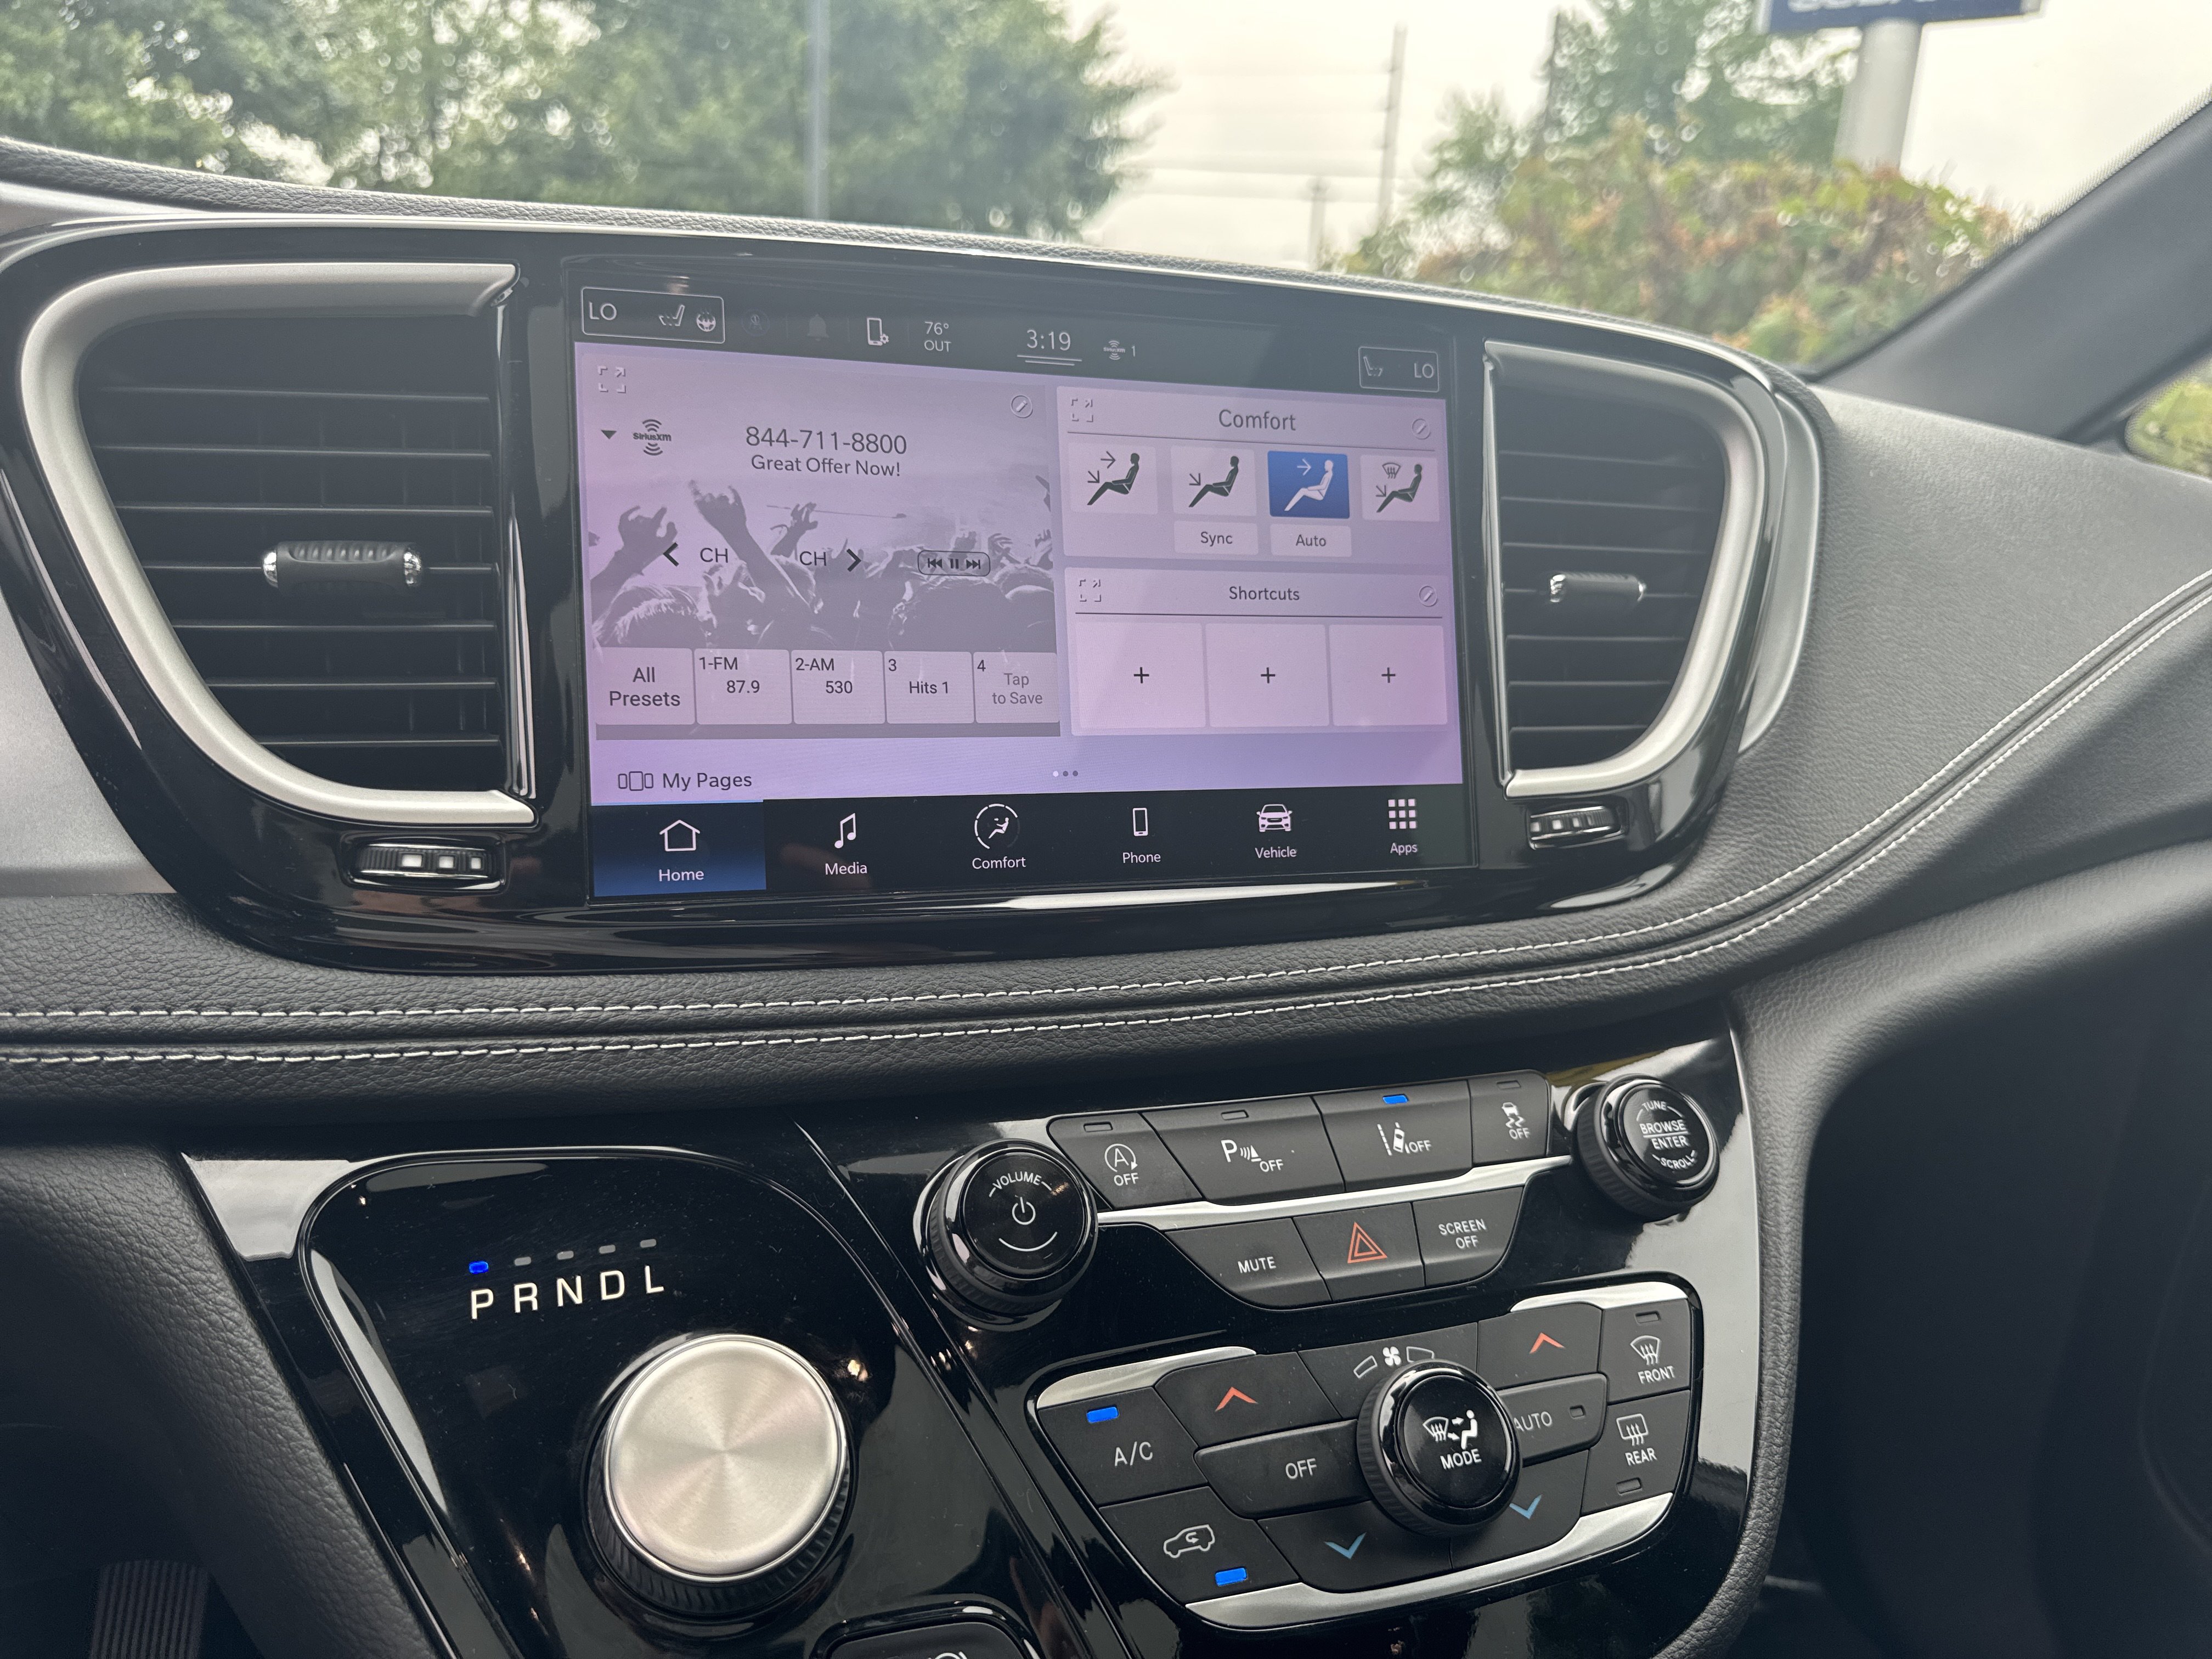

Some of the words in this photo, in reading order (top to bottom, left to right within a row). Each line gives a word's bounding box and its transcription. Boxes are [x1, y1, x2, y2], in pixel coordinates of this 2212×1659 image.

[589, 302, 617, 320] LO
[924, 340, 951, 352] OUT
[1026, 329, 1071, 351] 3:19
[1131, 345, 1136, 357] 1
[1414, 363, 1434, 379] LO
[1218, 409, 1296, 431] Comfort
[746, 426, 907, 455] 844-711-8800
[751, 454, 802, 472] Great
[806, 458, 851, 474] Offer
[856, 460, 900, 477] Now!
[1200, 531, 1233, 547] Sync
[1295, 534, 1327, 547] Auto
[700, 548, 729, 563] CH
[799, 551, 827, 567] CH
[1229, 586, 1300, 601] Shortcuts
[699, 657, 738, 670] 1-FM
[795, 657, 834, 671] 2-AM
[888, 658, 897, 672] 3
[977, 659, 986, 672] 4
[633, 667, 655, 682] All
[1003, 673, 1029, 689] Tap
[726, 680, 760, 693] 87.9
[826, 680, 853, 694] 530
[909, 681, 938, 694] Hits
[942, 681, 948, 694] 1
[610, 691, 680, 707] Presets
[991, 692, 1006, 704] to
[1010, 691, 1043, 704] Save
[663, 773, 691, 792] My
[697, 772, 752, 791] Pages
[1255, 846, 1297, 859] Vehicle
[1390, 842, 1418, 856] Apps
[972, 856, 1026, 870] Comfort
[1122, 851, 1161, 864] Phone
[659, 869, 704, 882] Home
[825, 861, 867, 875] Media
[1641, 1100, 1668, 1111] TUNE
[1509, 1126, 1530, 1140] OFF
[1639, 1119, 1686, 1134] BROWSE
[1409, 1140, 1431, 1153] OFF
[1651, 1135, 1690, 1150] ENTER
[1221, 1139, 1237, 1163] P
[1260, 1158, 1284, 1172] OFF
[1660, 1155, 1695, 1169] SCROLL
[992, 1171, 1042, 1189] VOLUME
[1113, 1172, 1139, 1186] OFF
[1438, 1218, 1487, 1235] SCREEN
[1455, 1235, 1478, 1249] OFF
[1238, 1256, 1276, 1273] MUTE
[471, 1289, 494, 1319] P
[514, 1283, 538, 1313] R
[556, 1276, 583, 1307] N
[600, 1270, 625, 1300] D
[645, 1265, 664, 1294] L
[1638, 1365, 1674, 1384] FRONT
[1514, 1411, 1552, 1432] AUTO
[1114, 1441, 1153, 1466] A/C
[1440, 1448, 1482, 1469] MODE
[1625, 1447, 1657, 1465] REAR
[1285, 1458, 1317, 1479] OFF
